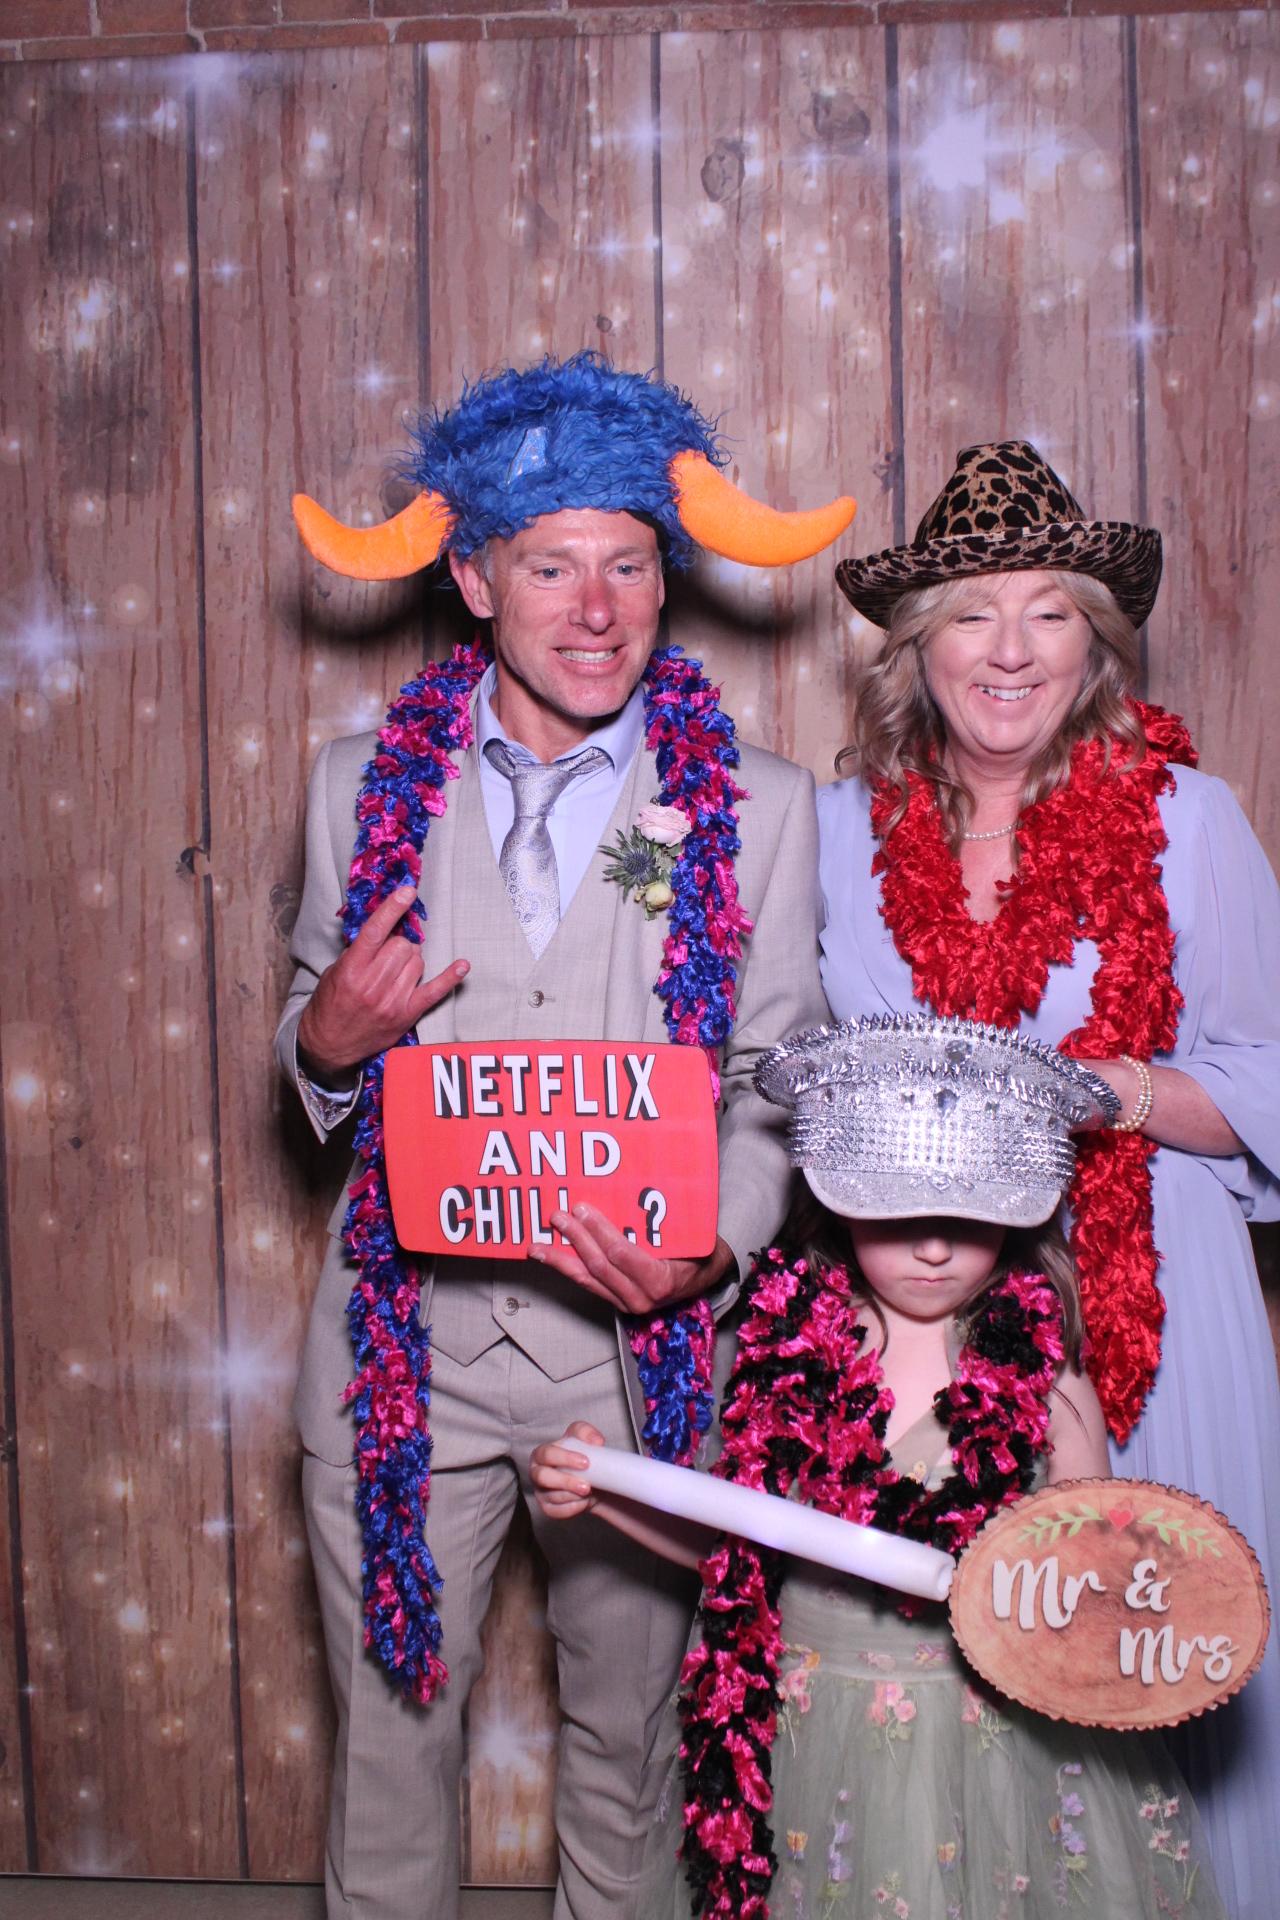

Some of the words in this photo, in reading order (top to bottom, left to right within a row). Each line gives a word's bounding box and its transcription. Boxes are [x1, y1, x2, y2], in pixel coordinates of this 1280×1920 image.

[431, 1053, 660, 1121] NETFLIX
[478, 1129, 622, 1177] AND
[991, 1555, 1107, 1631] Mr
[1124, 1558, 1172, 1614] &
[1118, 1624, 1240, 1686] Mrs
